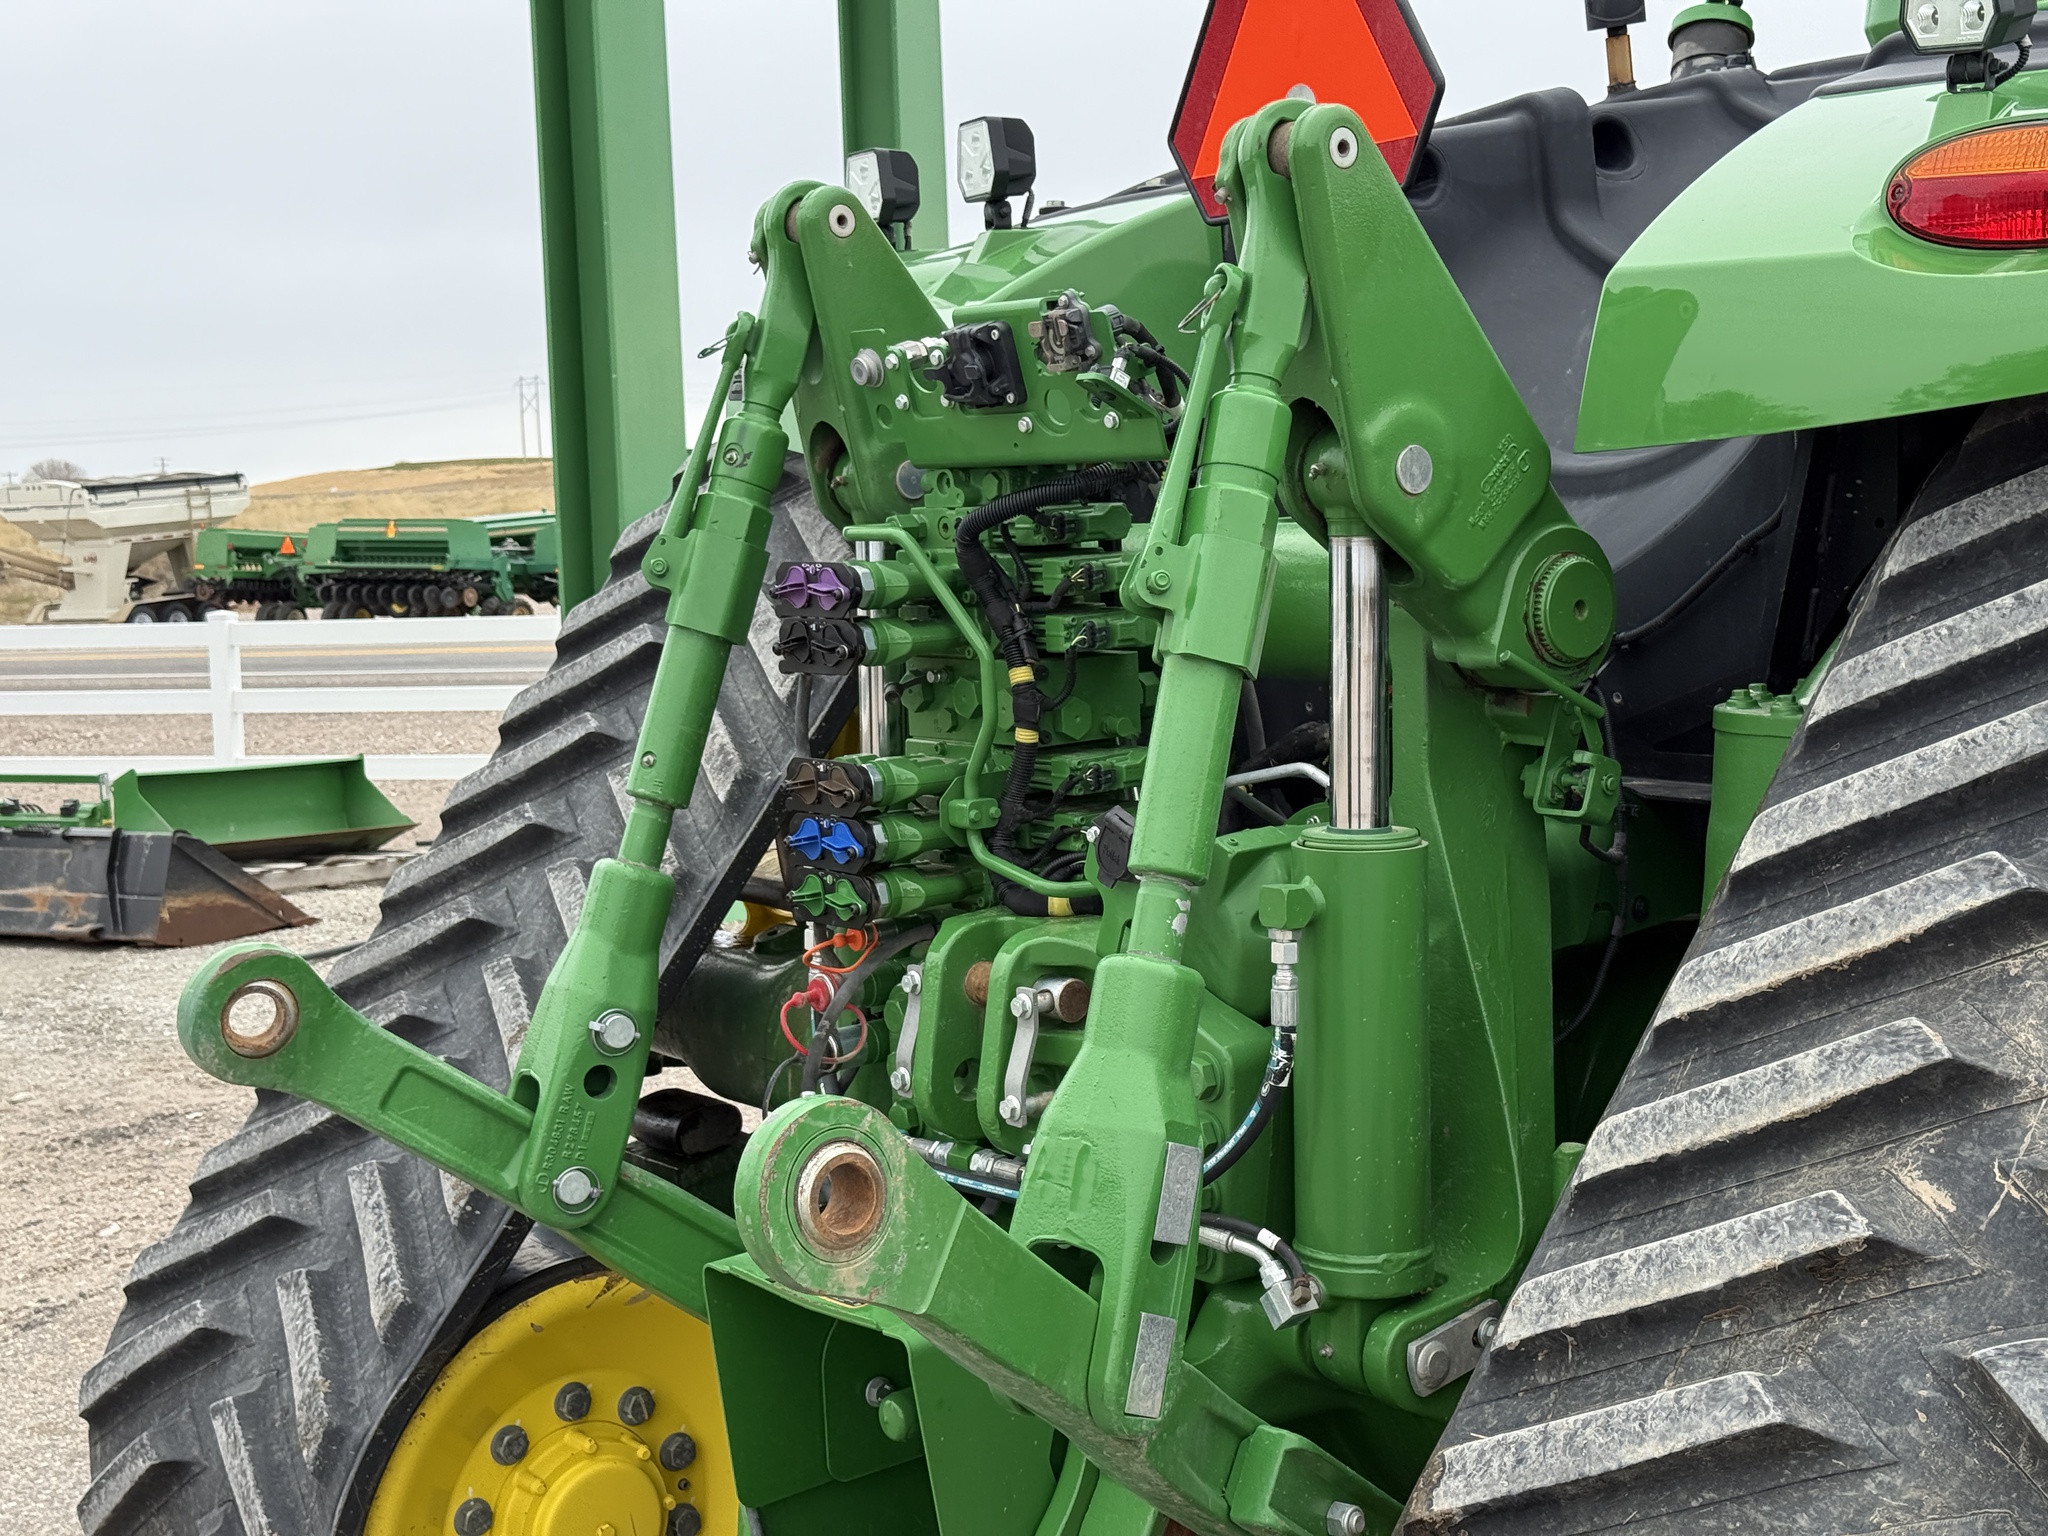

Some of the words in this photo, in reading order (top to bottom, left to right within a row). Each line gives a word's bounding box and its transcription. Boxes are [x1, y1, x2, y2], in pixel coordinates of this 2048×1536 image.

[542, 1118, 567, 1171] R304831
[558, 1083, 576, 1115] RAW
[562, 1101, 586, 1160] R298457
